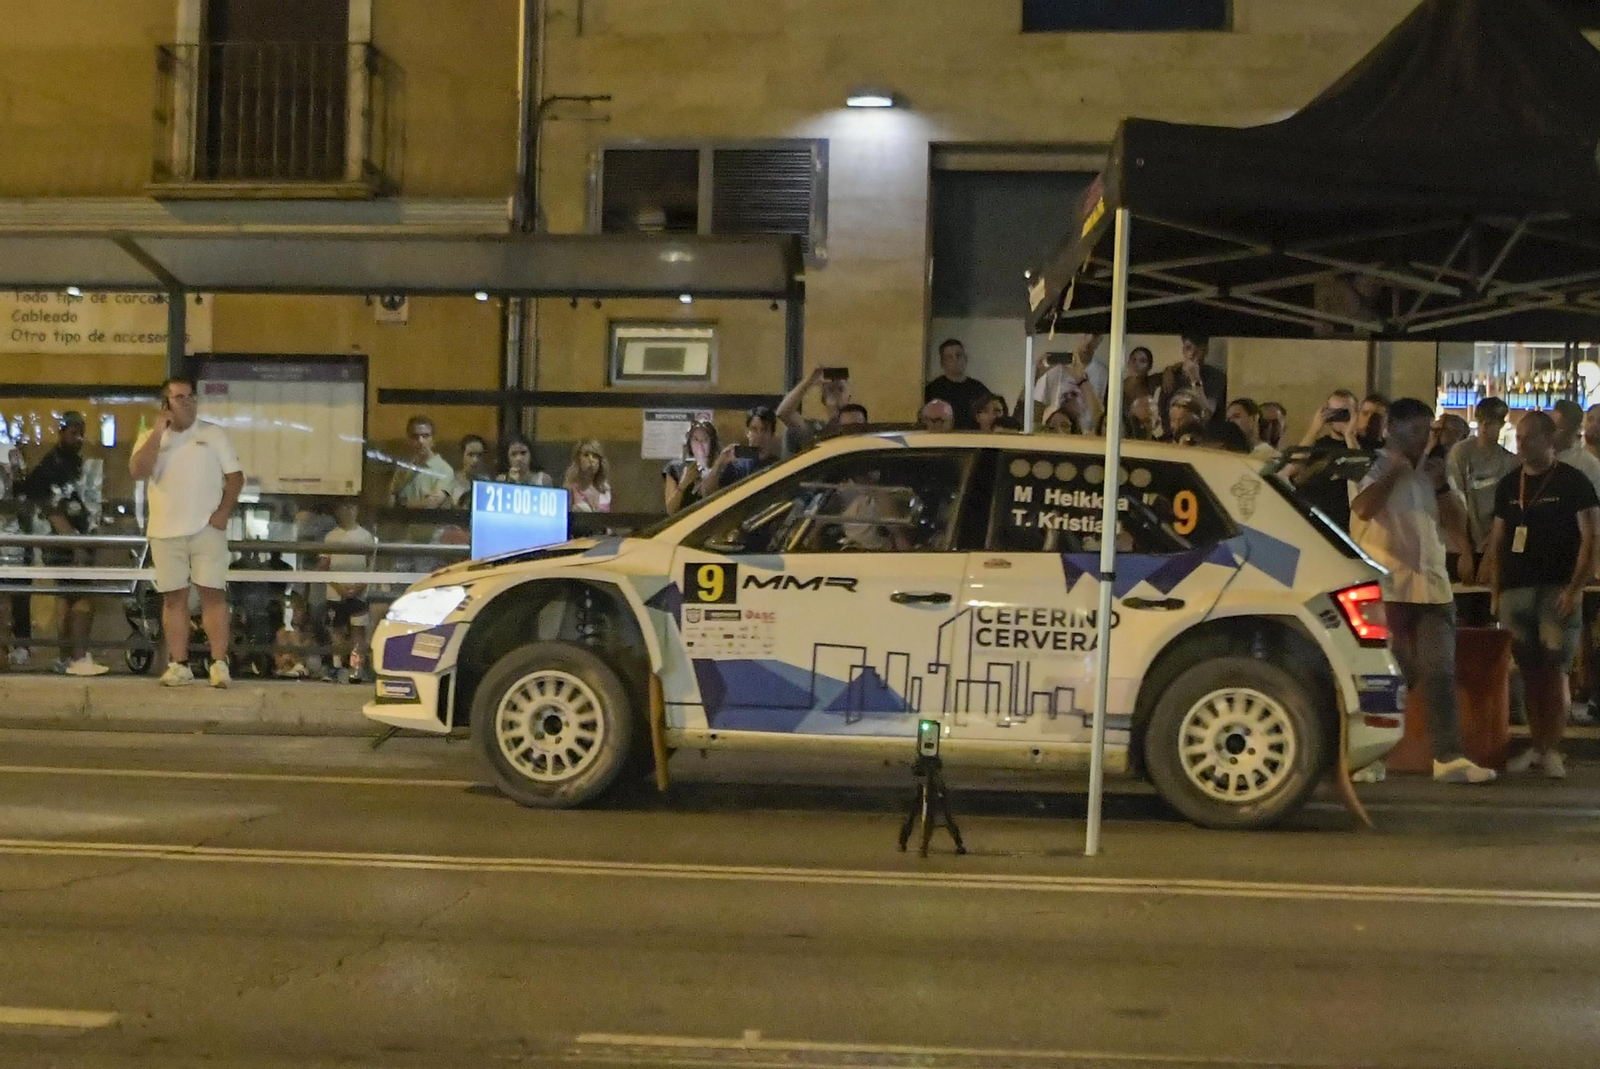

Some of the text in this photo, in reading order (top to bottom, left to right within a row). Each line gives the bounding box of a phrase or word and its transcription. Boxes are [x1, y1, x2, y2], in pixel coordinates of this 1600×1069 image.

[11, 310, 78, 323] Cableado
[11, 328, 46, 342] Otro
[54, 330, 81, 345] tipo
[88, 329, 106, 343] de
[486, 485, 557, 517] 21:00:00
[1044, 488, 1129, 512] Heikka
[1011, 509, 1032, 527] T.
[1173, 490, 1199, 535] 9
[697, 564, 725, 602] 9
[742, 574, 859, 592] MMR
